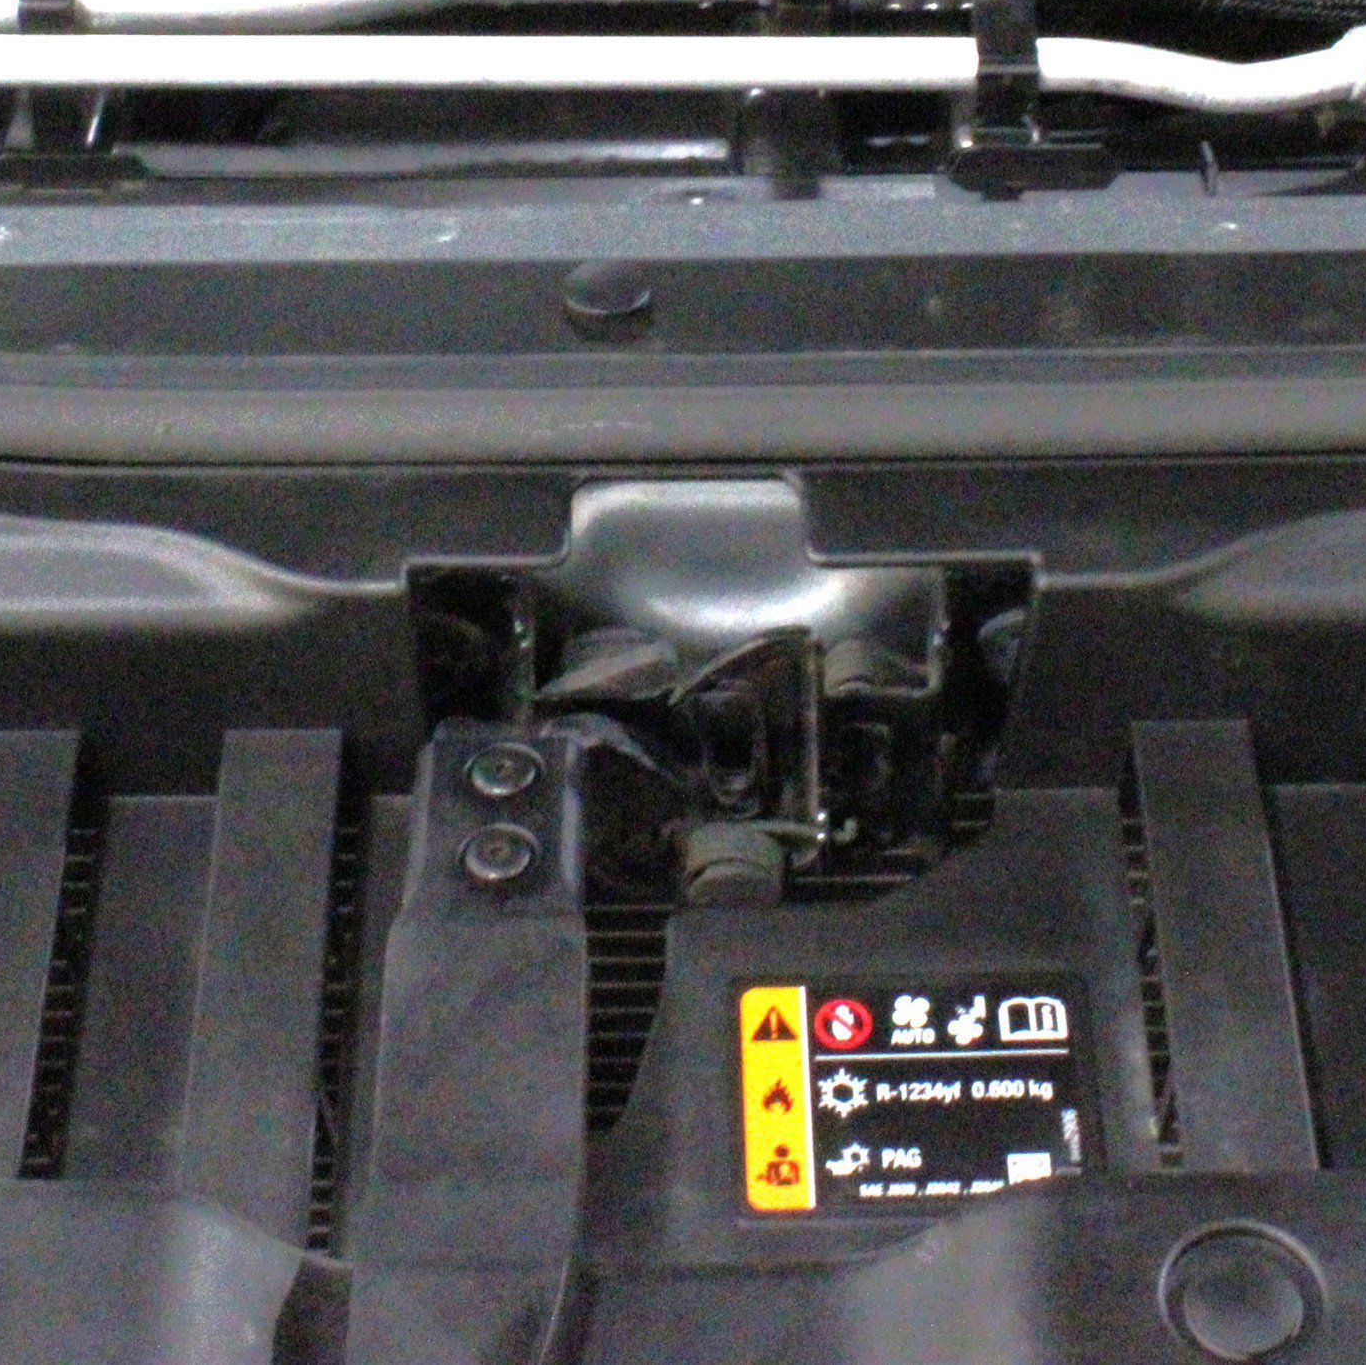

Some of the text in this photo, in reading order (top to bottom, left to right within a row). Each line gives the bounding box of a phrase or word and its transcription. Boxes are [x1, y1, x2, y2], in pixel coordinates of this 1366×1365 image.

[891, 1028, 935, 1044] AUTO
[876, 1081, 961, 1103] R-1234yf
[1028, 1079, 1053, 1101] kg
[881, 1147, 922, 1169] PAG
